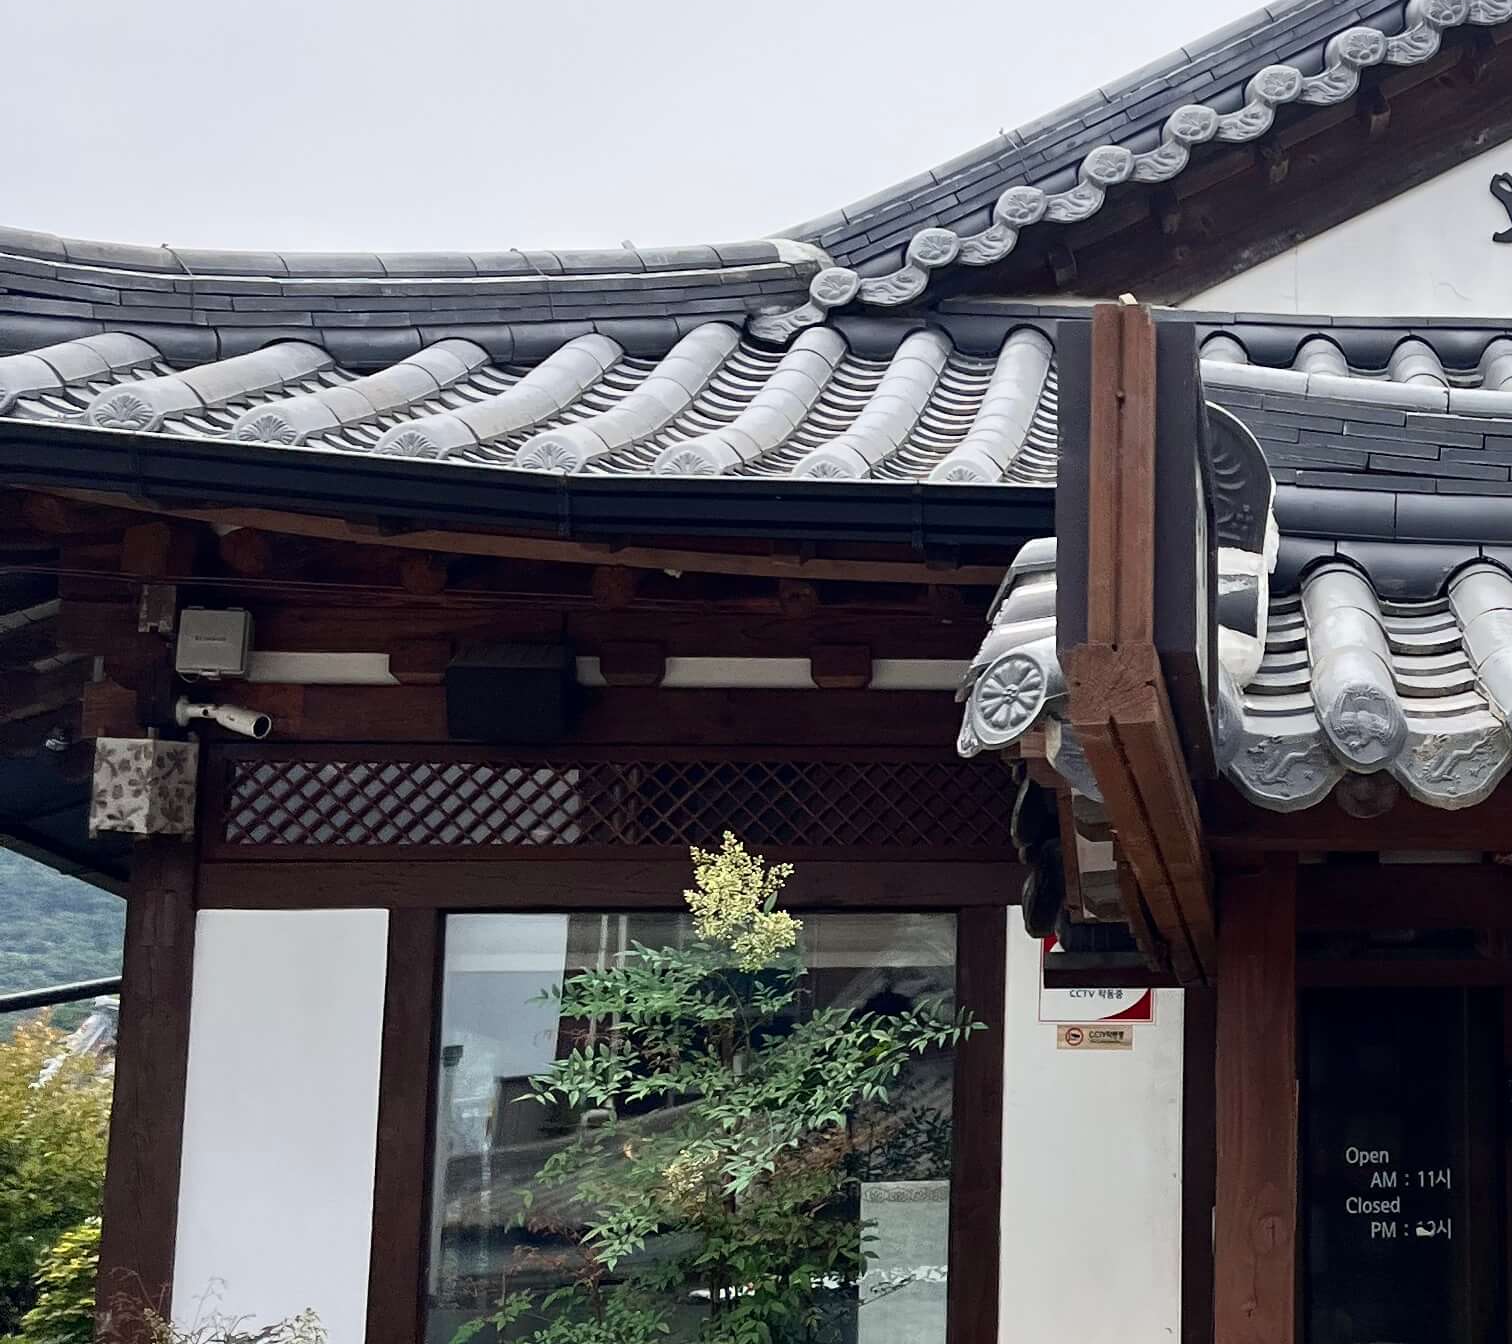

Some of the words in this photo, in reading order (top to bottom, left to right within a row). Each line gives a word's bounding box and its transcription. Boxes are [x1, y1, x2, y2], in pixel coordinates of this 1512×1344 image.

[1069, 989, 1095, 998] CCTV
[1345, 1146, 1389, 1167] Open
[1369, 1170, 1397, 1188] AM
[1416, 1167, 1452, 1190] 11시
[1345, 1195, 1401, 1214] Closed
[1370, 1220, 1397, 1239] PM
